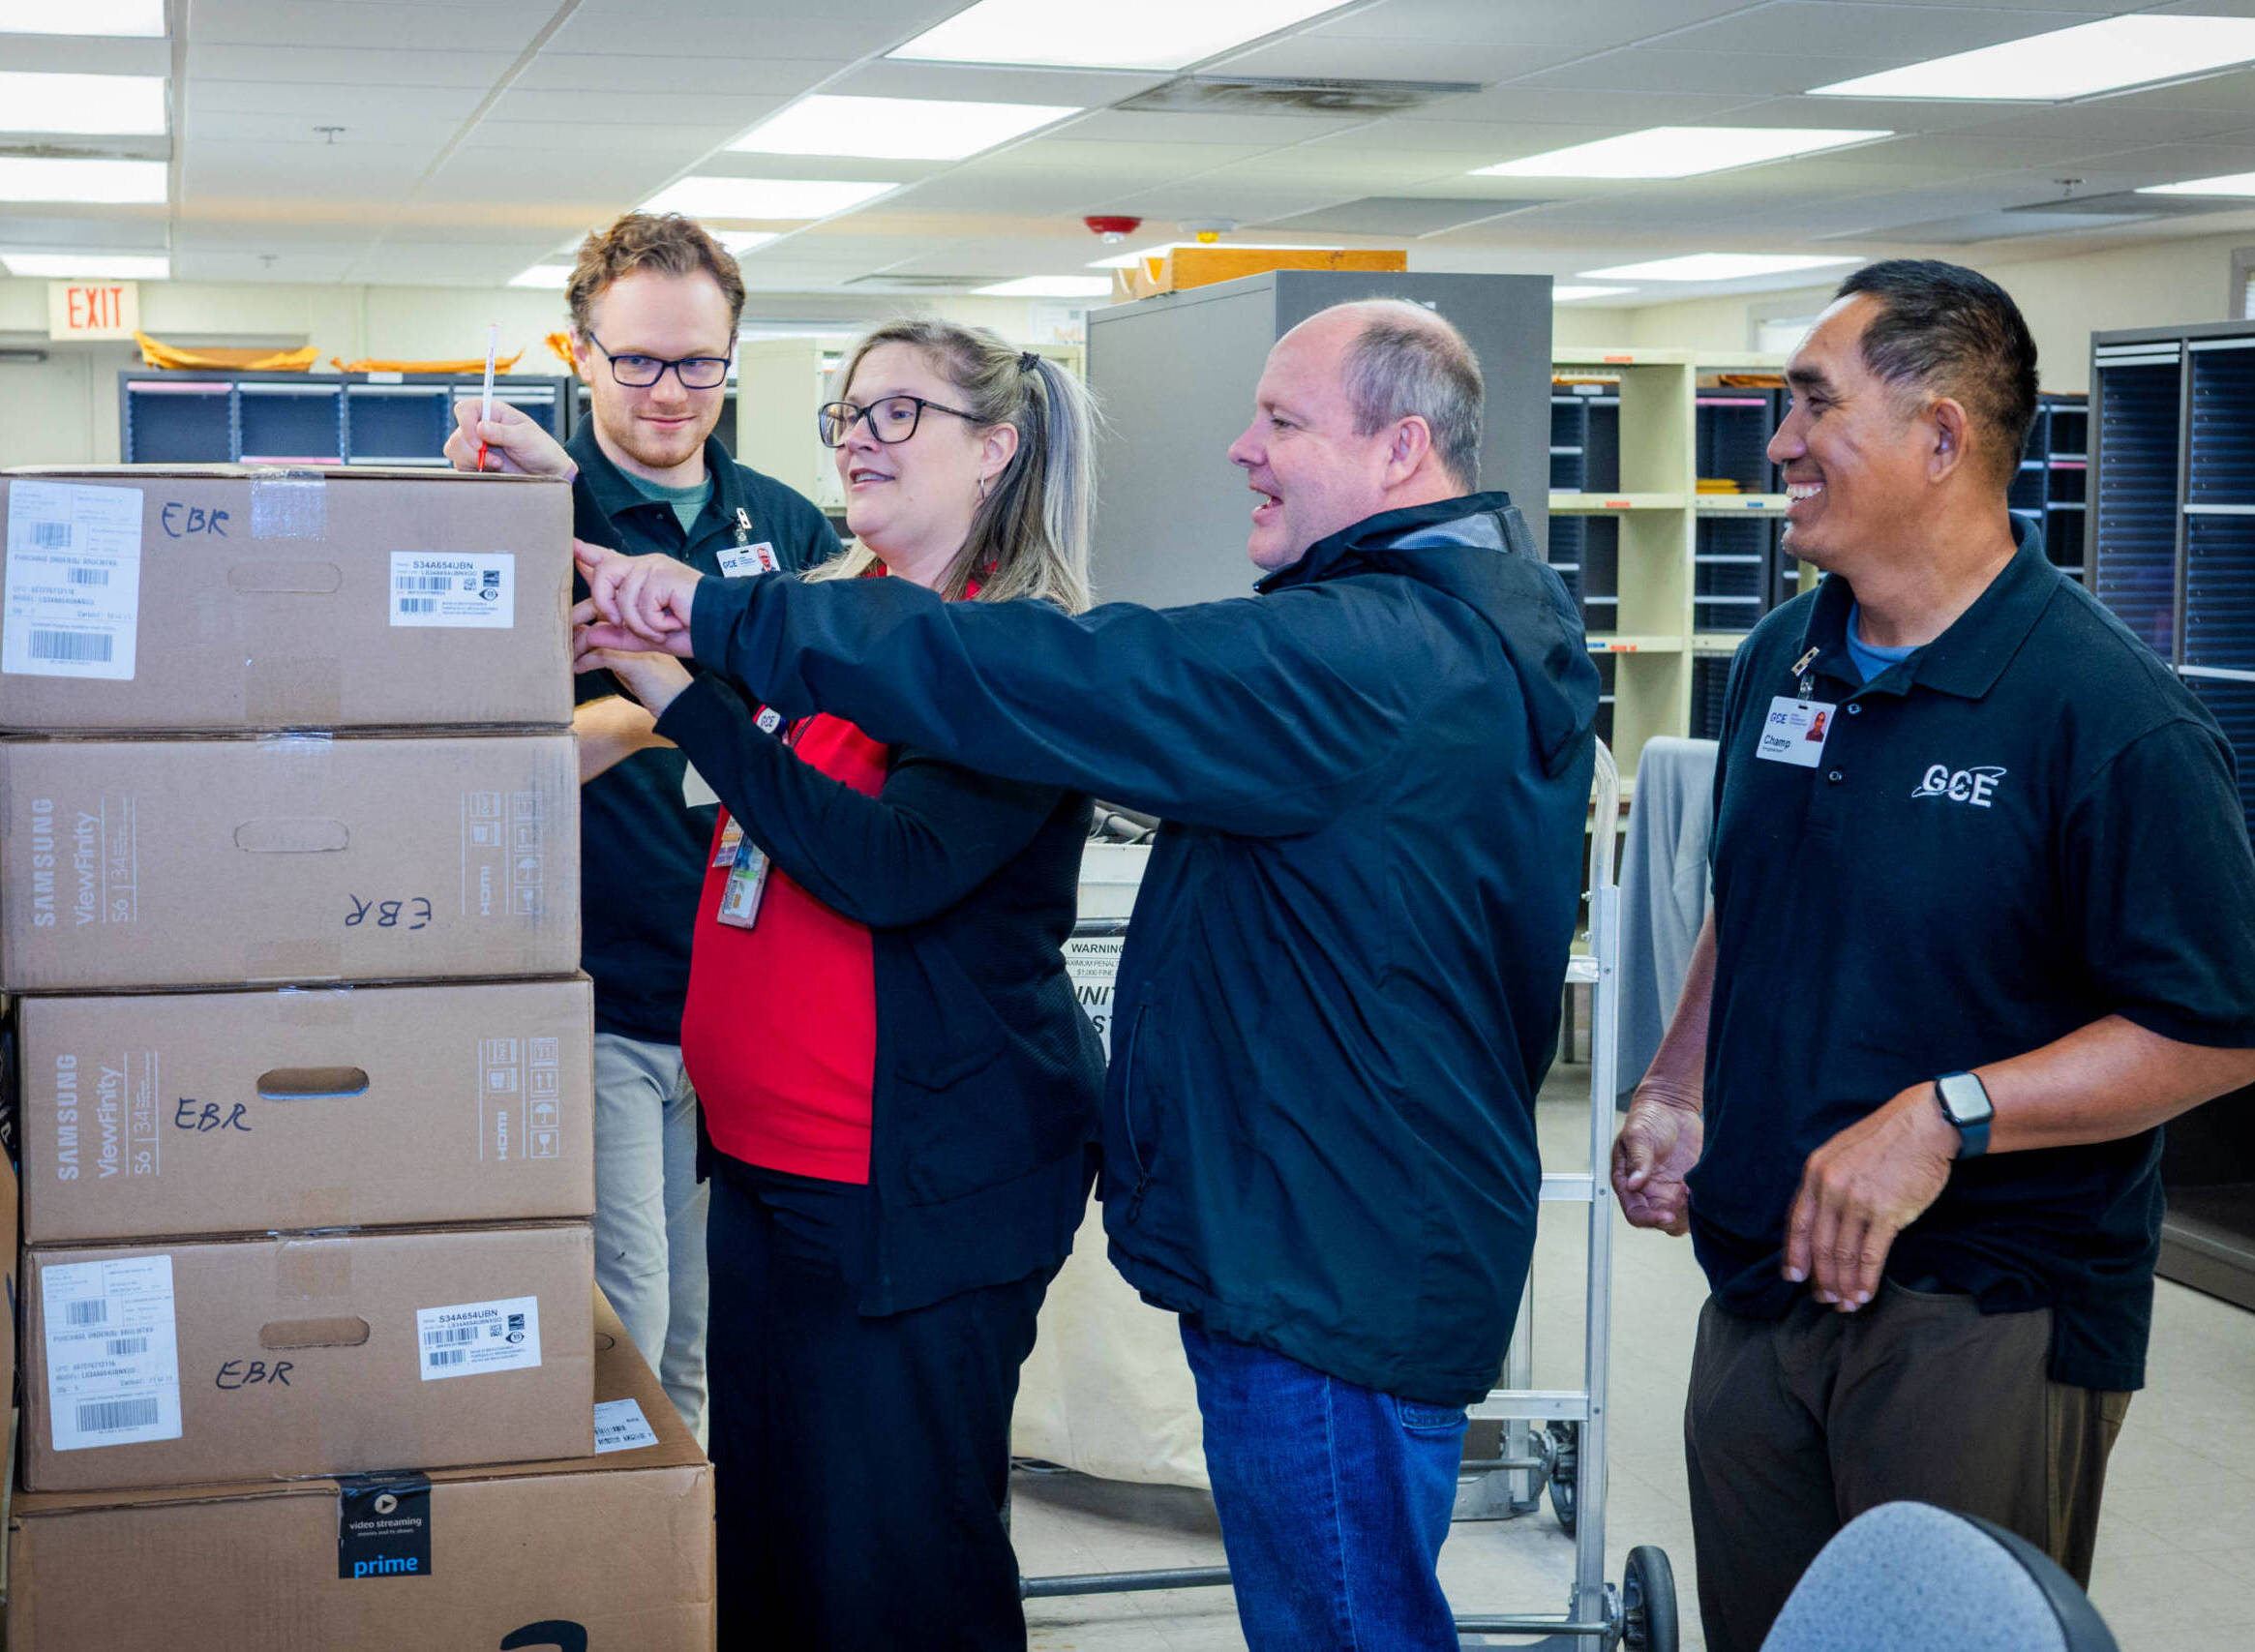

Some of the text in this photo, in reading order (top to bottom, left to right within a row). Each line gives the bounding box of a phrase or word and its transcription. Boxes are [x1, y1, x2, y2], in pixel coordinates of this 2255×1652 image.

[68, 287, 124, 328] EXIT
[161, 502, 229, 537] EBR
[1770, 712, 1788, 724] GCE
[1763, 735, 1790, 749] Champ
[1921, 765, 1999, 808] GCE
[32, 798, 55, 926] SAMSUNG
[74, 811, 101, 926] ViewFinity
[345, 893, 433, 930] EBR
[56, 1054, 79, 1181] SAMSUNG
[96, 1066, 123, 1179] ViewFinity
[175, 1097, 252, 1131] EBR
[496, 1110, 508, 1160] HDMI
[135, 1151, 151, 1175] S6
[439, 1309, 498, 1323] S34A654UBN
[216, 1359, 294, 1389] EBR
[349, 1517, 422, 1529] video streaming
[353, 1554, 419, 1578] prime
